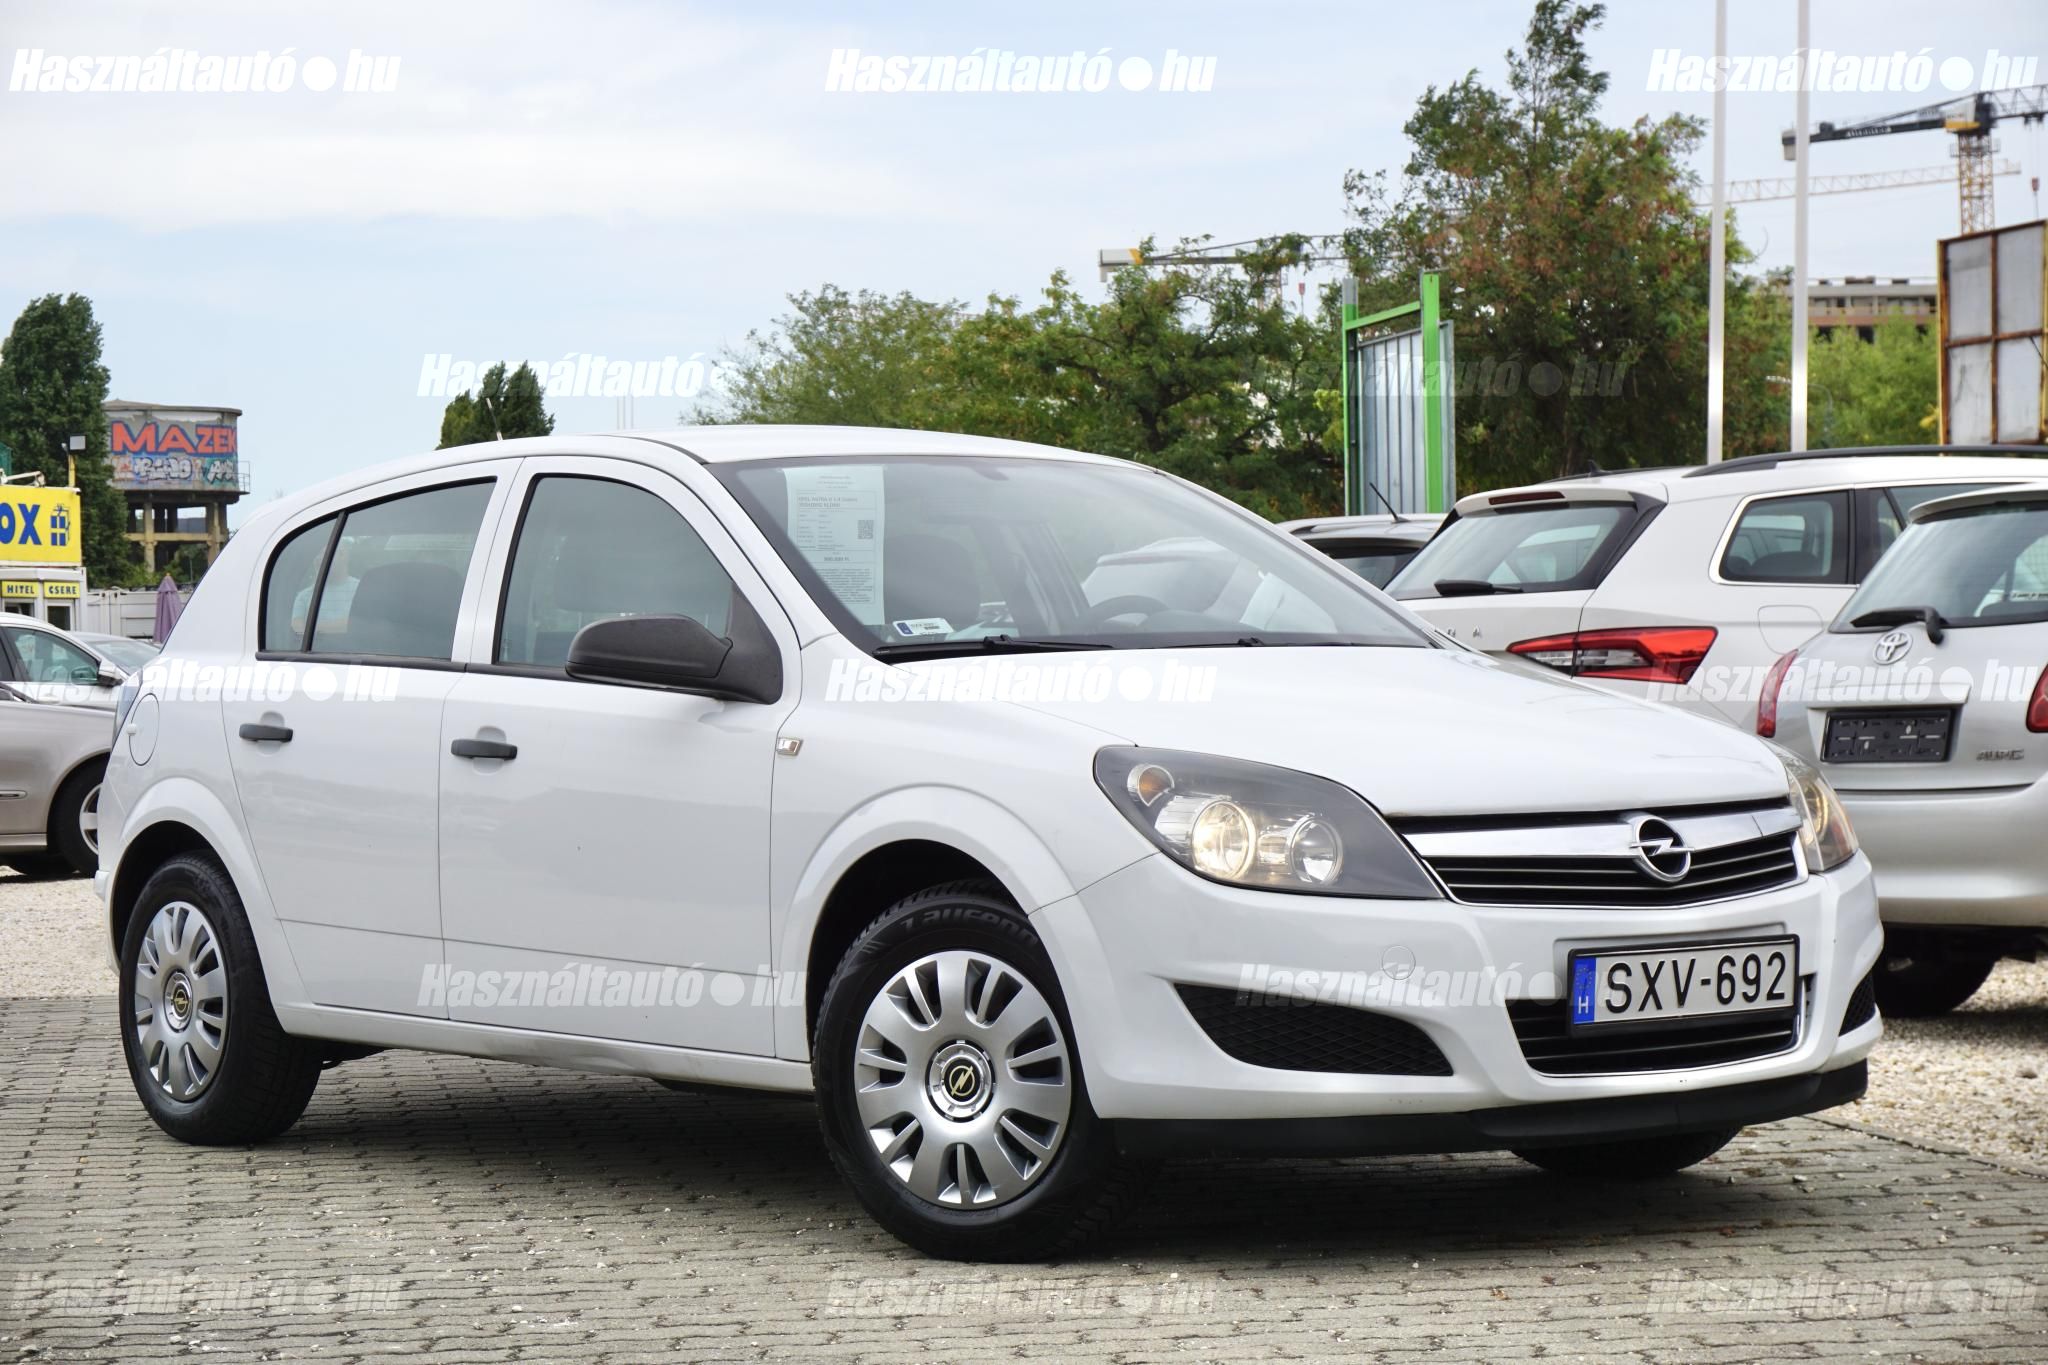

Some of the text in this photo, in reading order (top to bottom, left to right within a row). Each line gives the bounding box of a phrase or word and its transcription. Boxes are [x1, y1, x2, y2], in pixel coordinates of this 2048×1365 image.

[0, 503, 42, 545] OX
[7, 585, 35, 594] HITEL
[48, 586, 77, 594] CSERE
[1578, 951, 1786, 1015] H SXV-692
